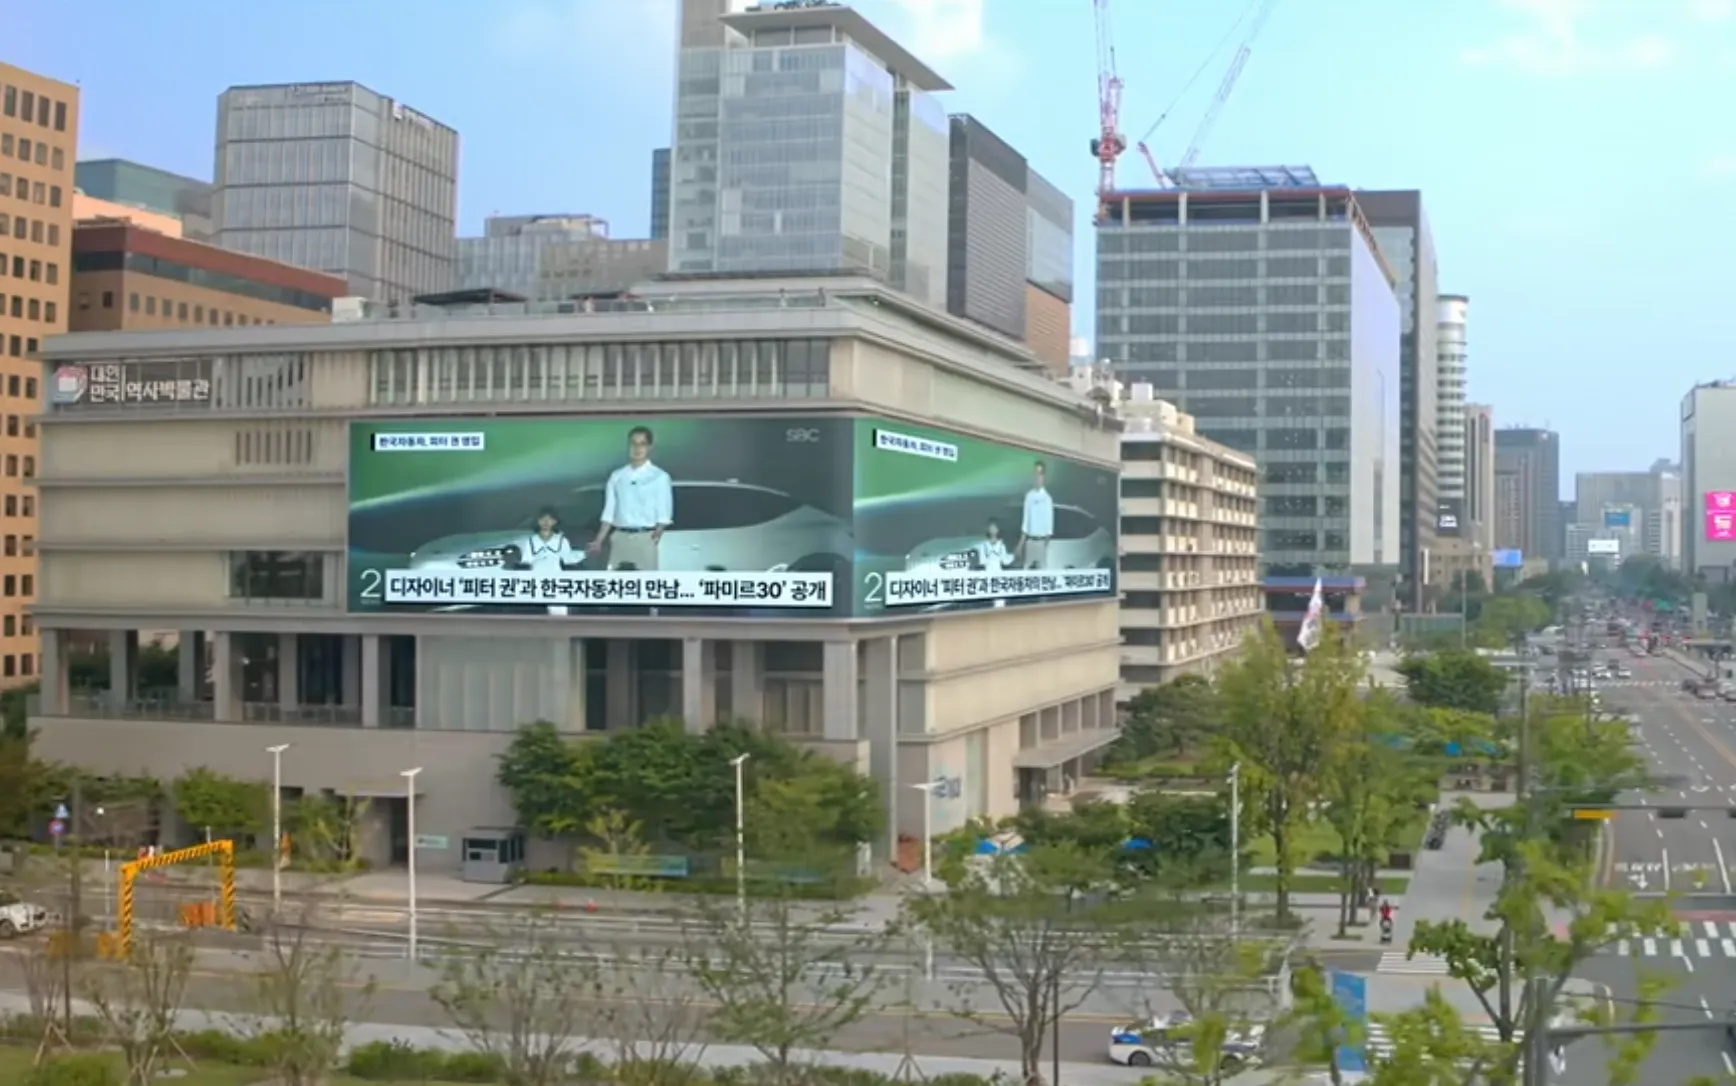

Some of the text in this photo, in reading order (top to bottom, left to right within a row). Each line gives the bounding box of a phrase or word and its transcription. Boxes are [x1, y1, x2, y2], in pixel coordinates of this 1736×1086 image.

[91, 384, 120, 402] 민국
[126, 379, 210, 401] 역사박물관
[360, 568, 381, 598] 2
[391, 577, 455, 597] 디자이너
[541, 578, 641, 599] 한국자동차의
[790, 580, 827, 601] 공개
[864, 571, 883, 602] 2
[890, 578, 938, 599] 디자이너
